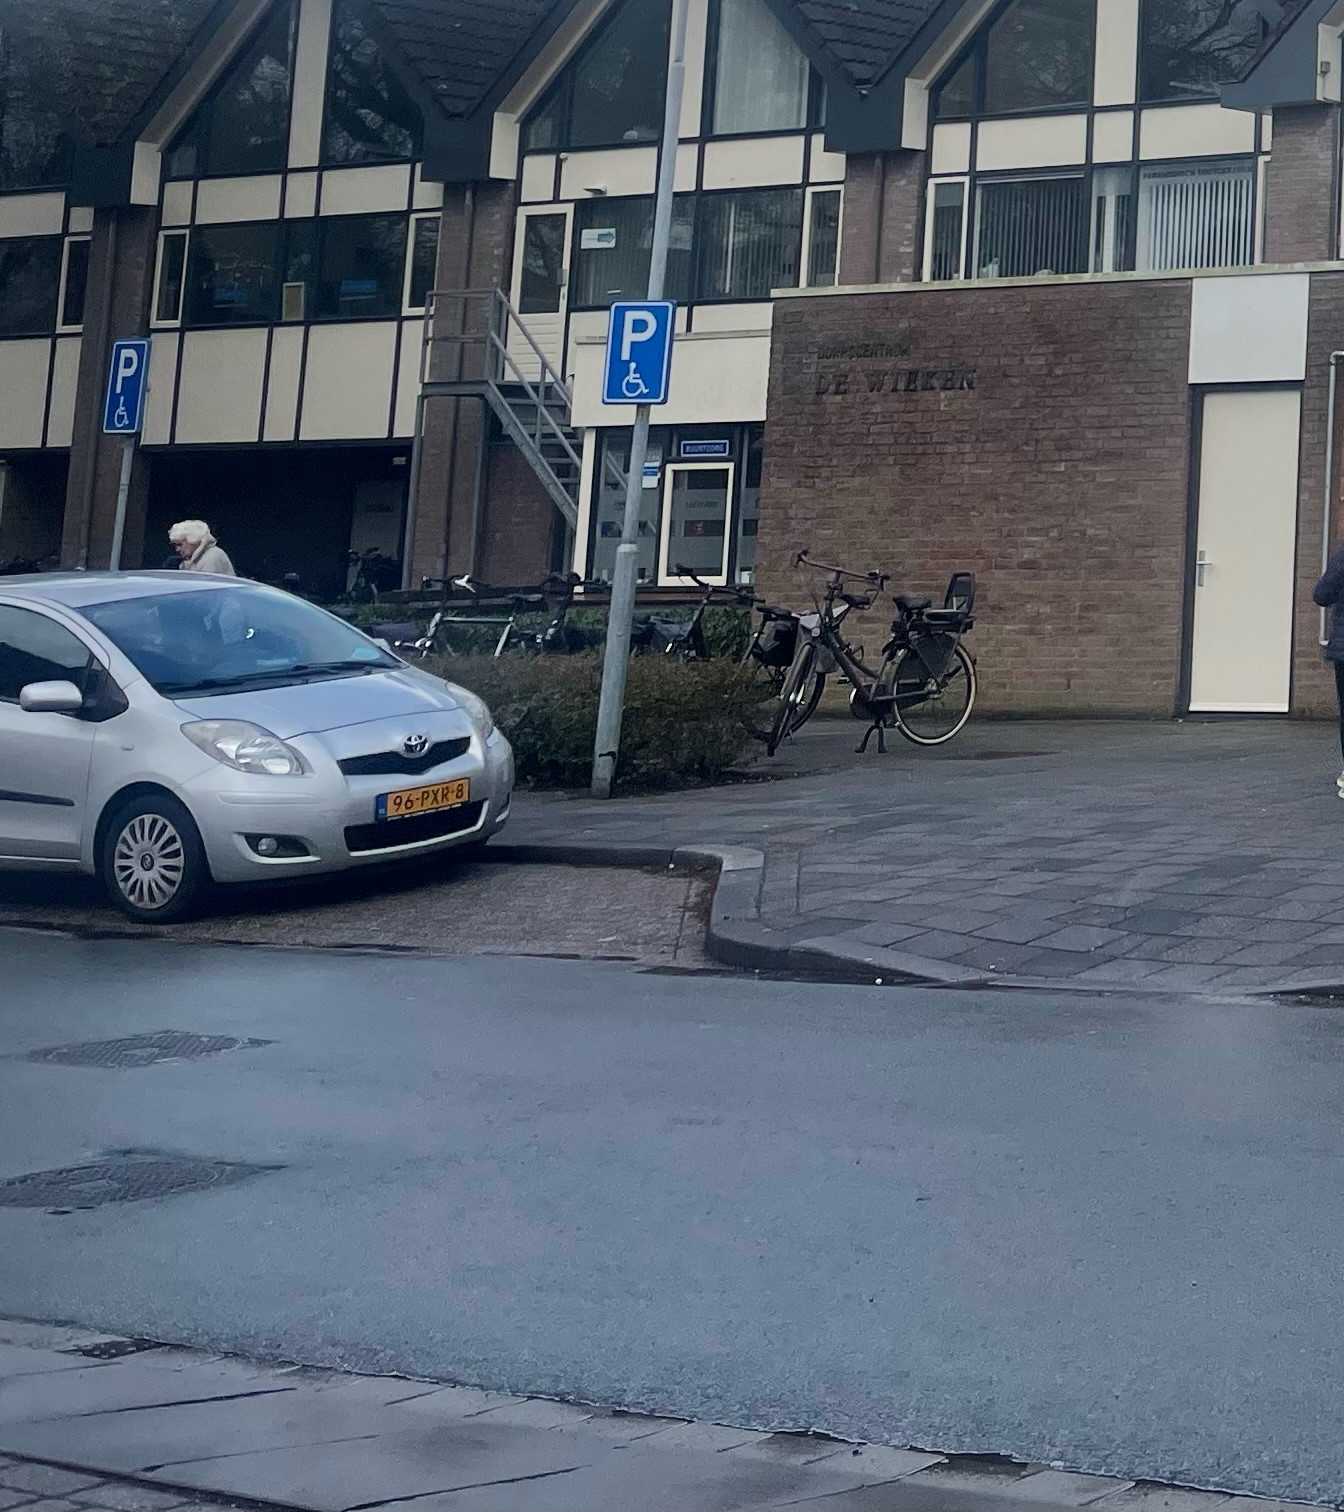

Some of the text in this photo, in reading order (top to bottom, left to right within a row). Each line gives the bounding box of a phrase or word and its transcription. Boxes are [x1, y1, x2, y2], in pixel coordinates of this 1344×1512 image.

[620, 310, 657, 361] P
[115, 348, 138, 394] P
[816, 369, 977, 395] DE WIEKEN
[393, 783, 465, 813] 96-PXR-8
